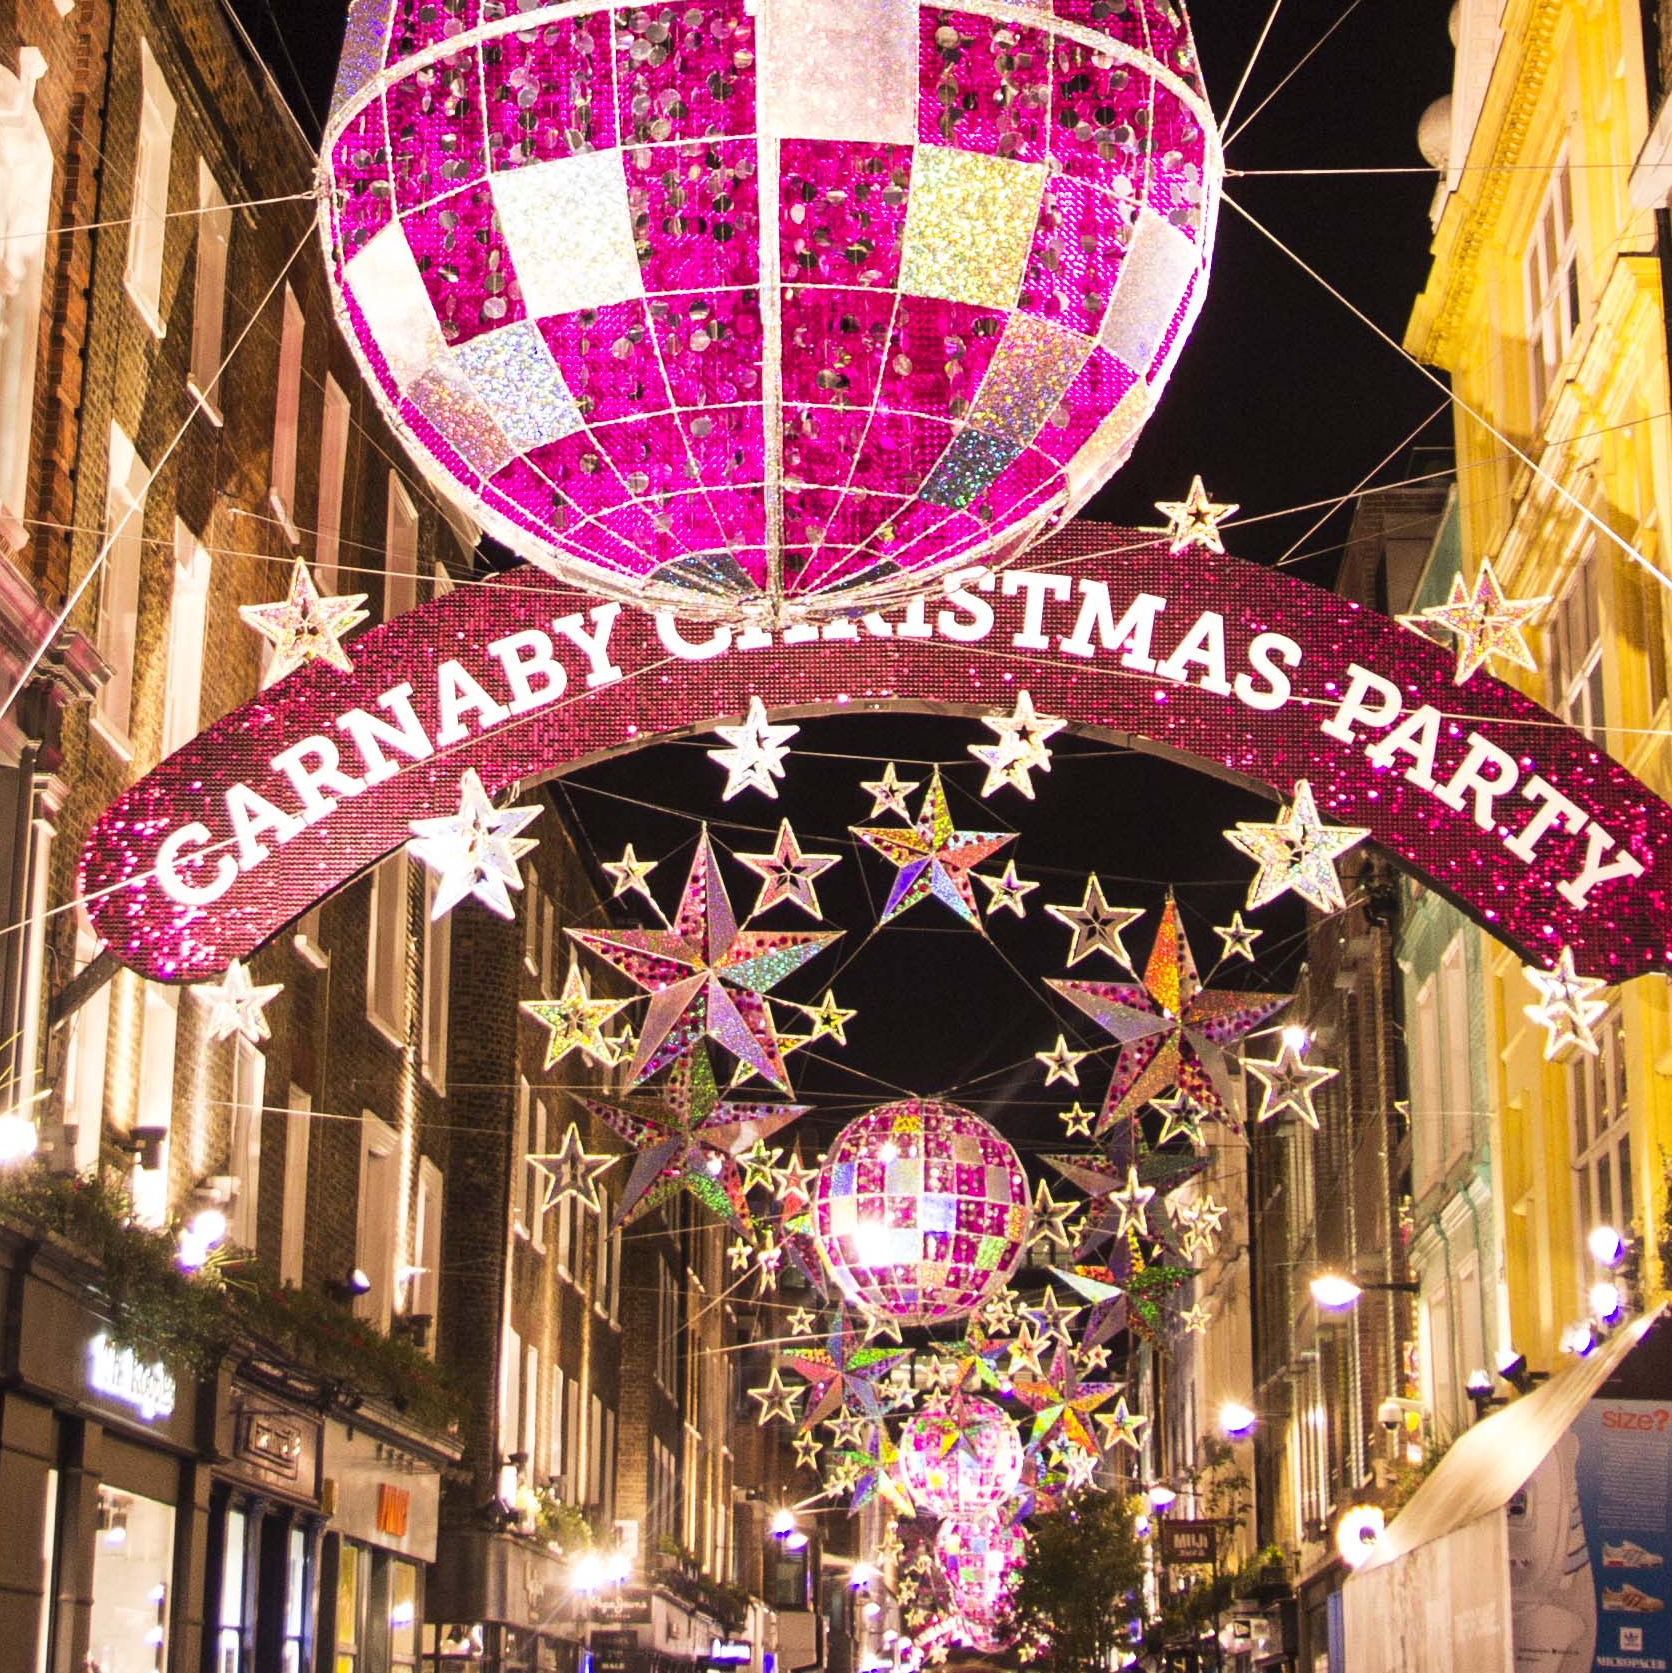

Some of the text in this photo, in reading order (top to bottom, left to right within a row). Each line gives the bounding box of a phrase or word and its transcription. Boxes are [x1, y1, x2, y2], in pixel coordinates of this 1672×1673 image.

[155, 567, 1646, 911] CARNABY CISTMAS PARTY
[1601, 1406, 1671, 1433] size?
